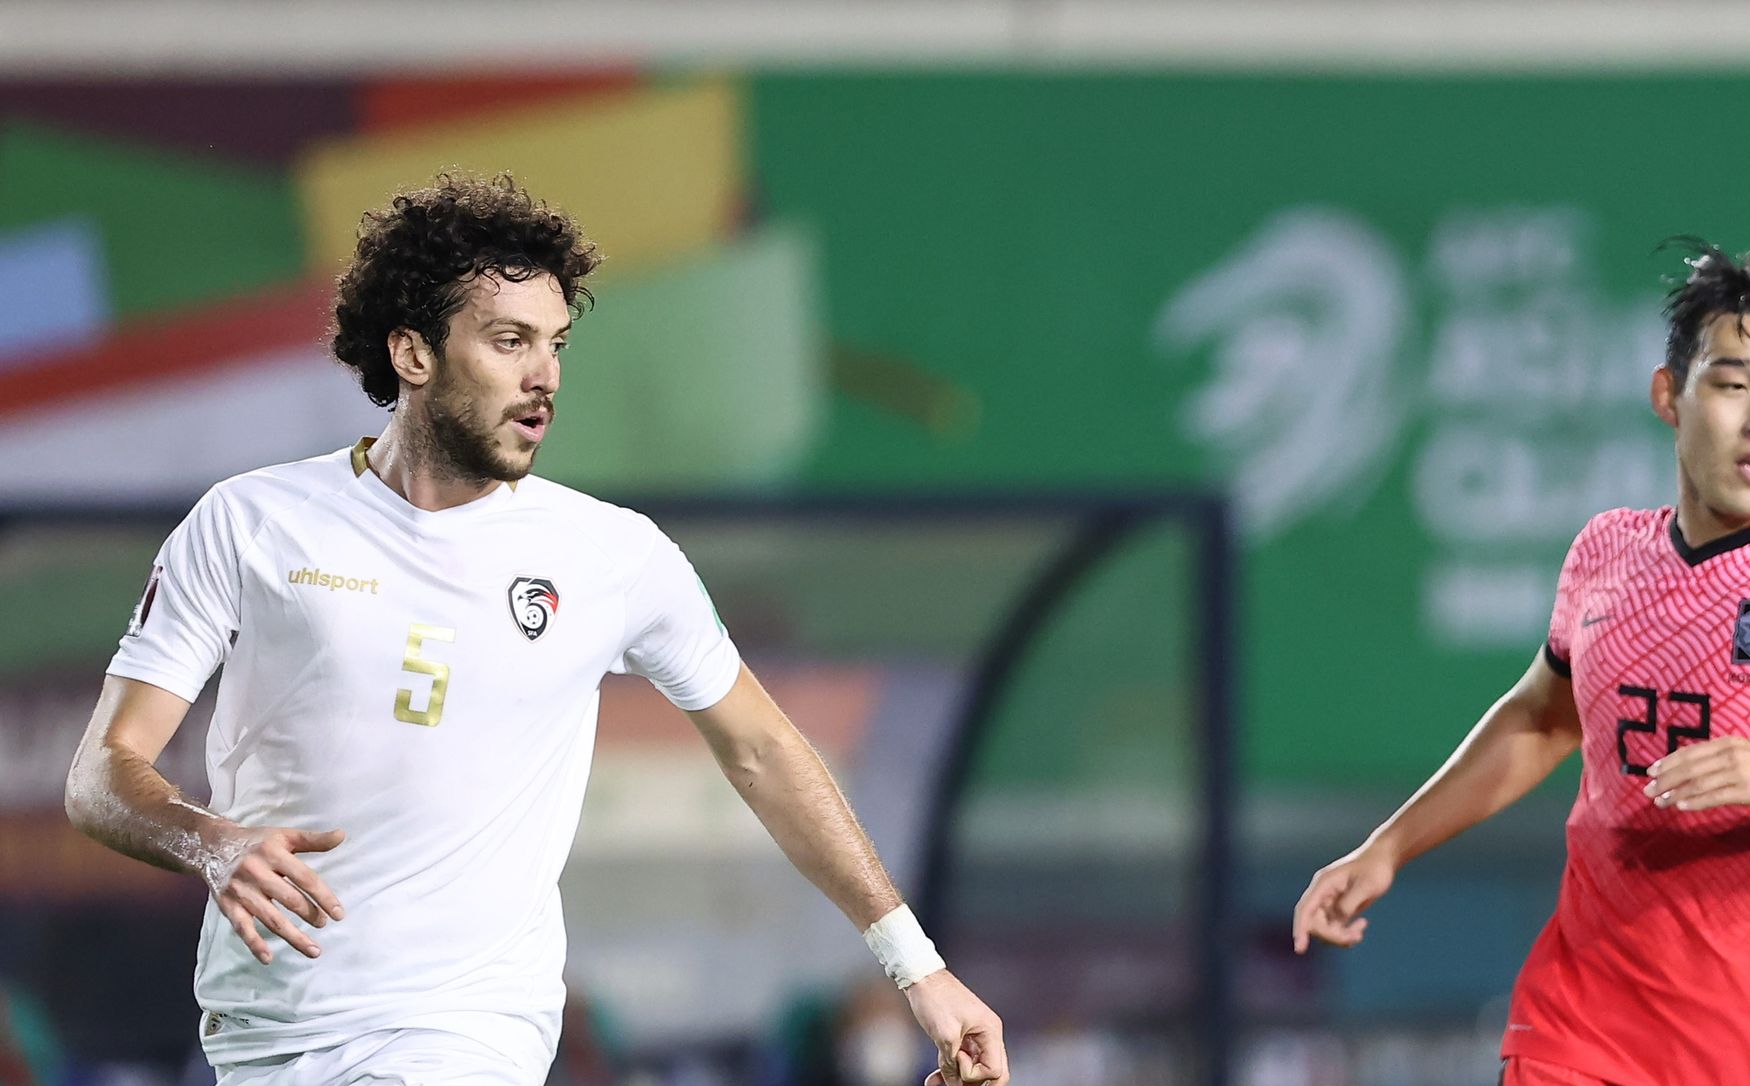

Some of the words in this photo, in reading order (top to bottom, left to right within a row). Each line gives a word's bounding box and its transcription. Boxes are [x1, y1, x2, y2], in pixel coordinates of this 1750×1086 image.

[288, 567, 379, 595] uhlsport
[393, 623, 457, 728] 5
[1617, 684, 1711, 777] 22
